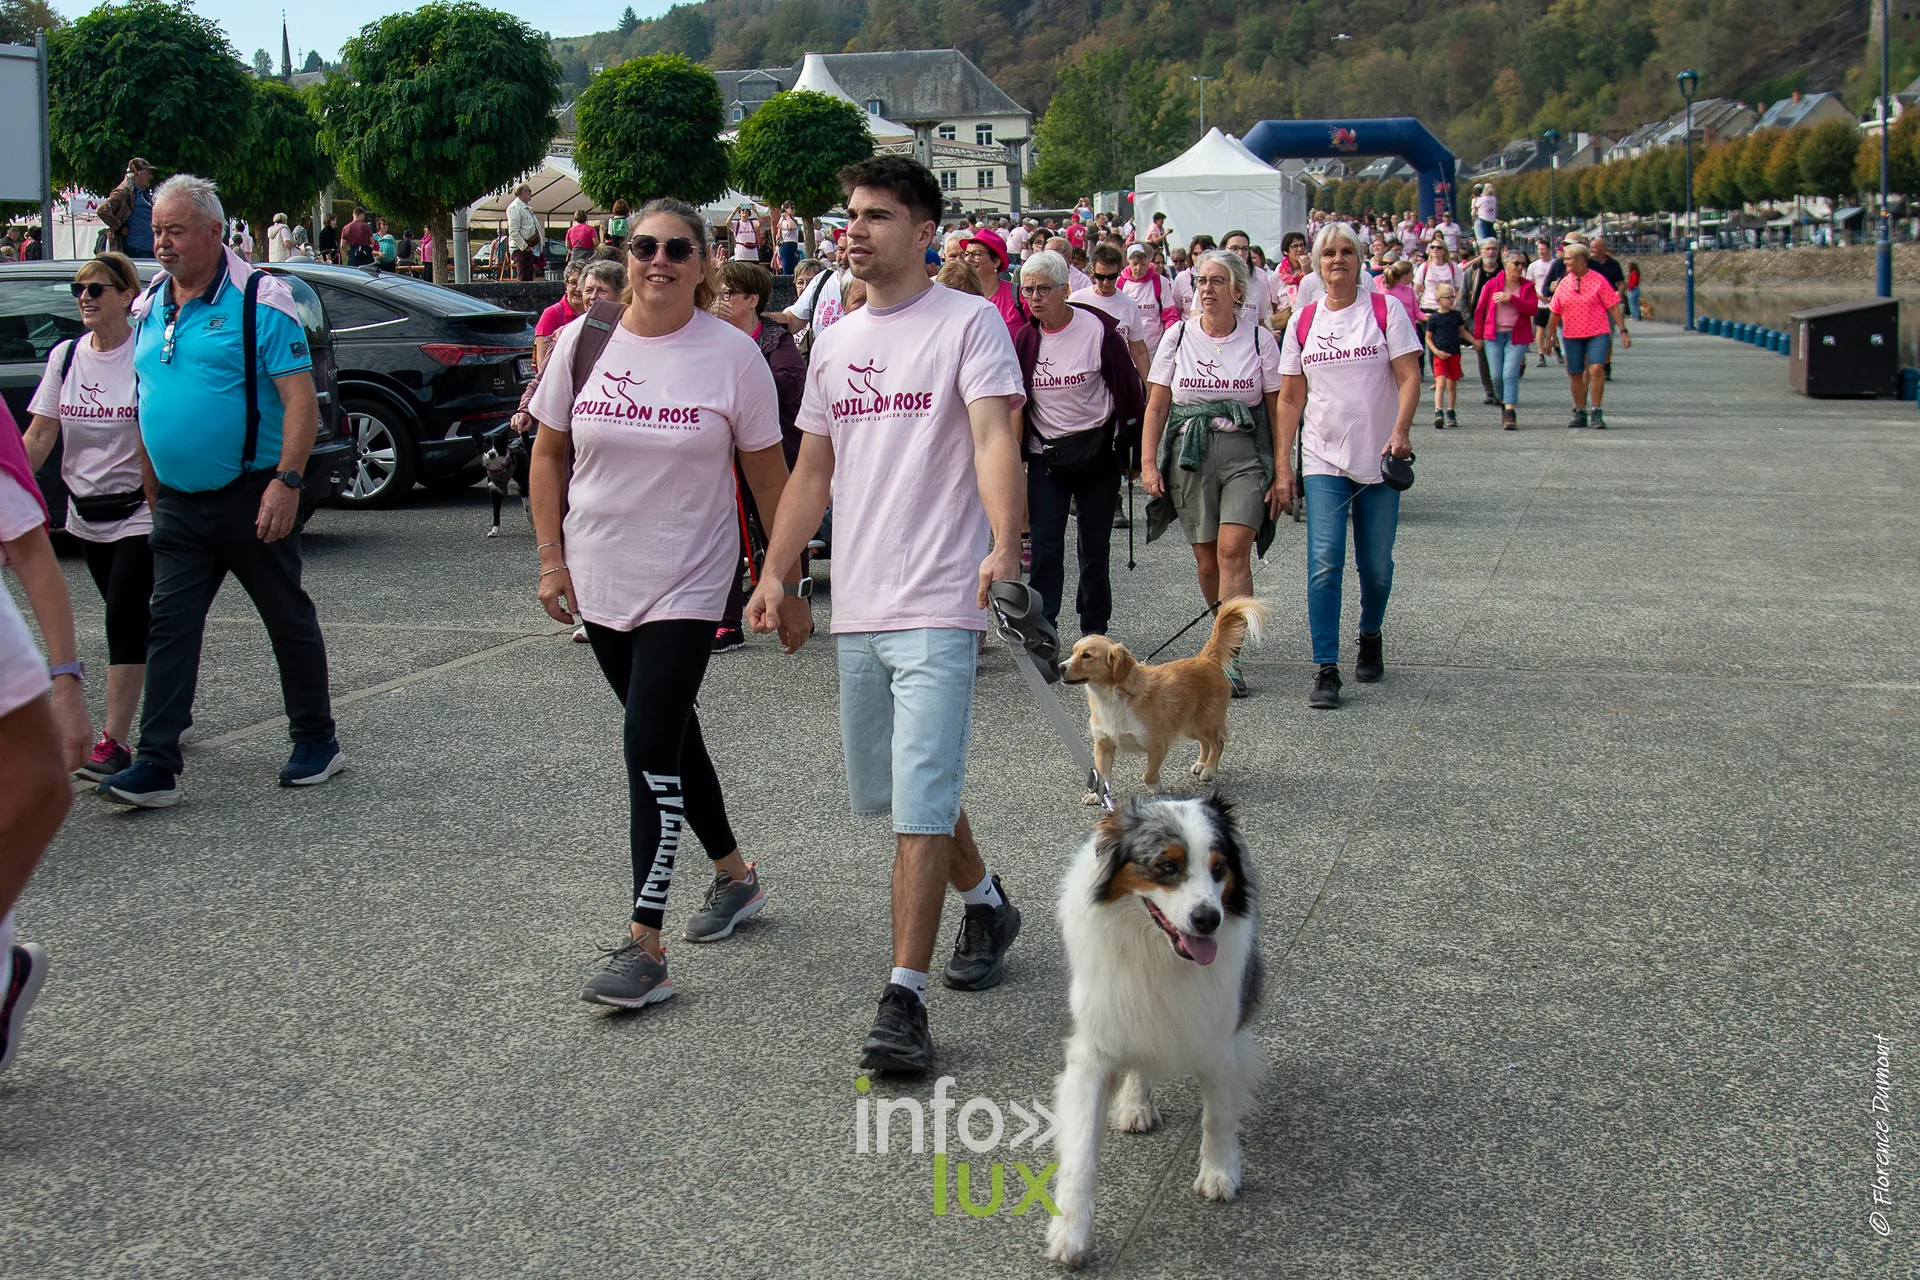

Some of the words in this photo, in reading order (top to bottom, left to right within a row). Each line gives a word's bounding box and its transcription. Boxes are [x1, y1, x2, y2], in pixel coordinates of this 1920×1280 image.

[1303, 349, 1351, 366] BOUILLON
[1354, 345, 1378, 358] ROSE
[1064, 373, 1087, 386] ROSE
[1179, 377, 1230, 389] BOUILLON
[1232, 378, 1255, 390] ROSE
[60, 404, 114, 419] BOUILLON
[574, 400, 653, 420] BOUILLON
[659, 407, 700, 424] ROSE
[832, 394, 891, 420] BOUILLON
[894, 392, 933, 411] ROSE
[593, 417, 622, 425] CONTRE
